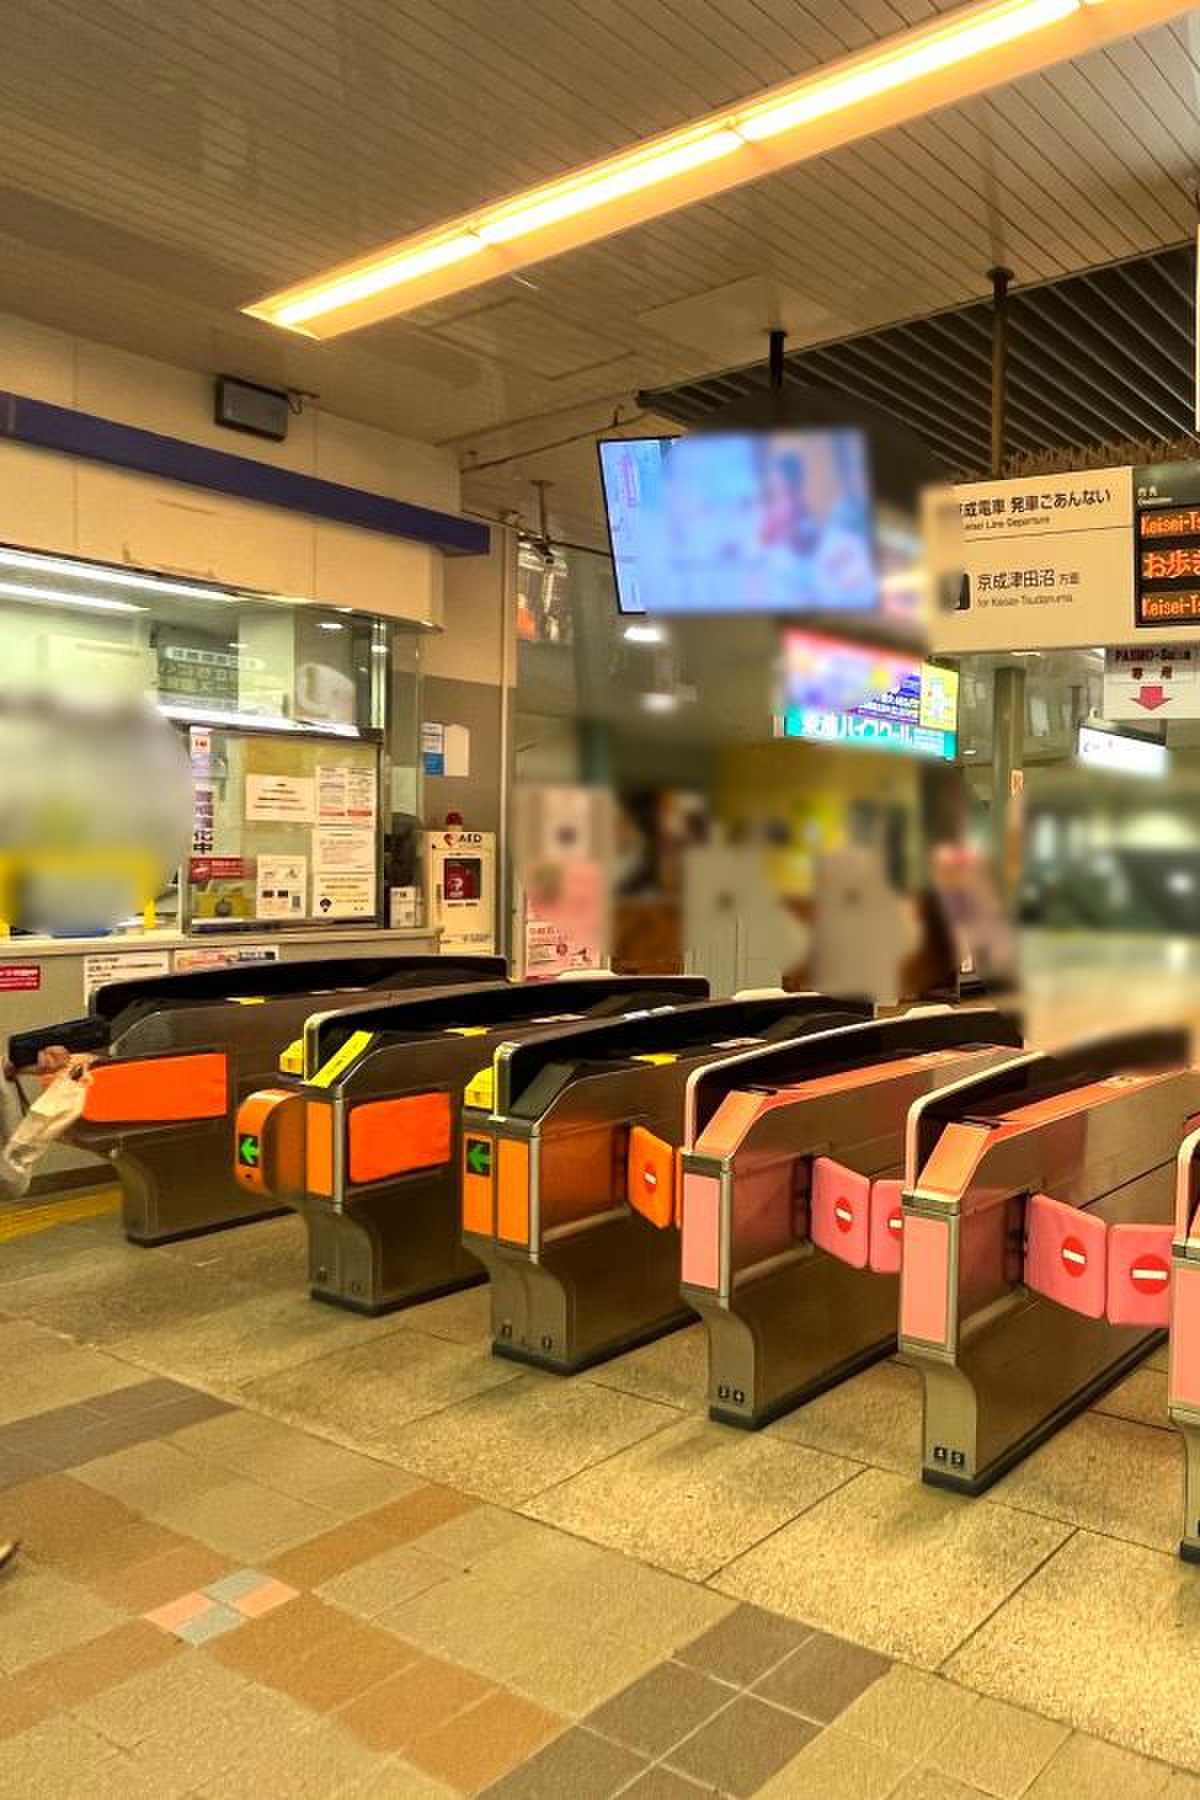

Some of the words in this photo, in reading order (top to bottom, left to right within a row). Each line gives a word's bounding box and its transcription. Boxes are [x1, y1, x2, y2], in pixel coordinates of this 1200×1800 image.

[1011, 489, 1111, 513] 発車ごあんない
[977, 568, 1056, 591] 京成津田沼
